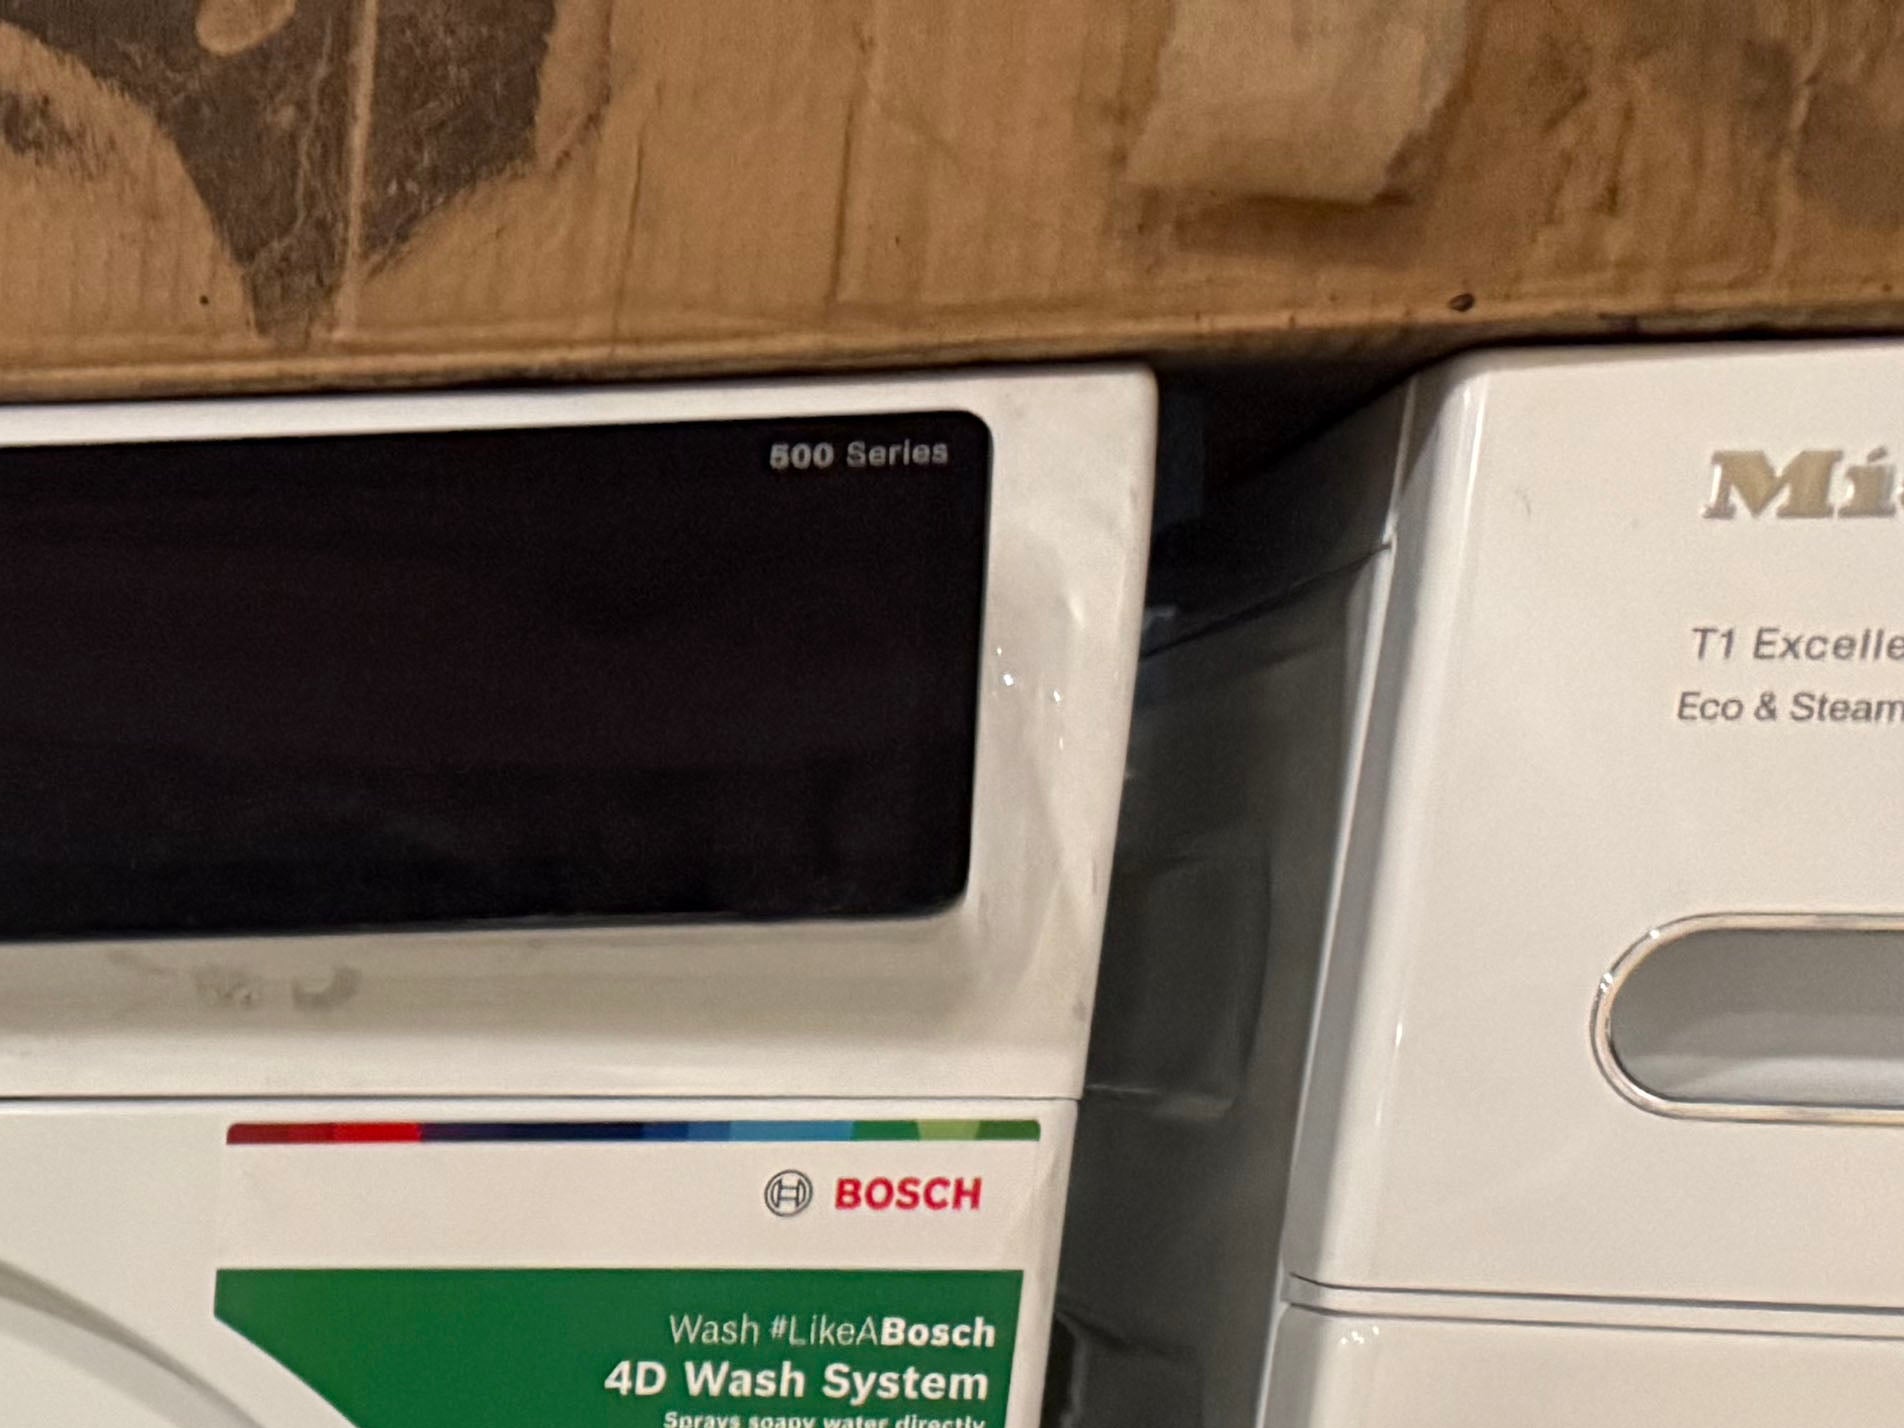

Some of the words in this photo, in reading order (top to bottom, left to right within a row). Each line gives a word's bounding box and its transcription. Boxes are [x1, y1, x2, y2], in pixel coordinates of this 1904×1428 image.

[770, 442, 834, 470] 500
[847, 440, 948, 467] Series
[1701, 446, 1904, 520] Mi
[1692, 626, 1736, 661] T1
[1678, 691, 1743, 721] Eco
[1754, 691, 1778, 721] &
[835, 1176, 982, 1211] BOSCH
[670, 1314, 760, 1345] Wash
[770, 1315, 995, 1347] #LikeABosch
[604, 1360, 666, 1396] 4D
[685, 1361, 804, 1397] Wash
[822, 1364, 989, 1405] System
